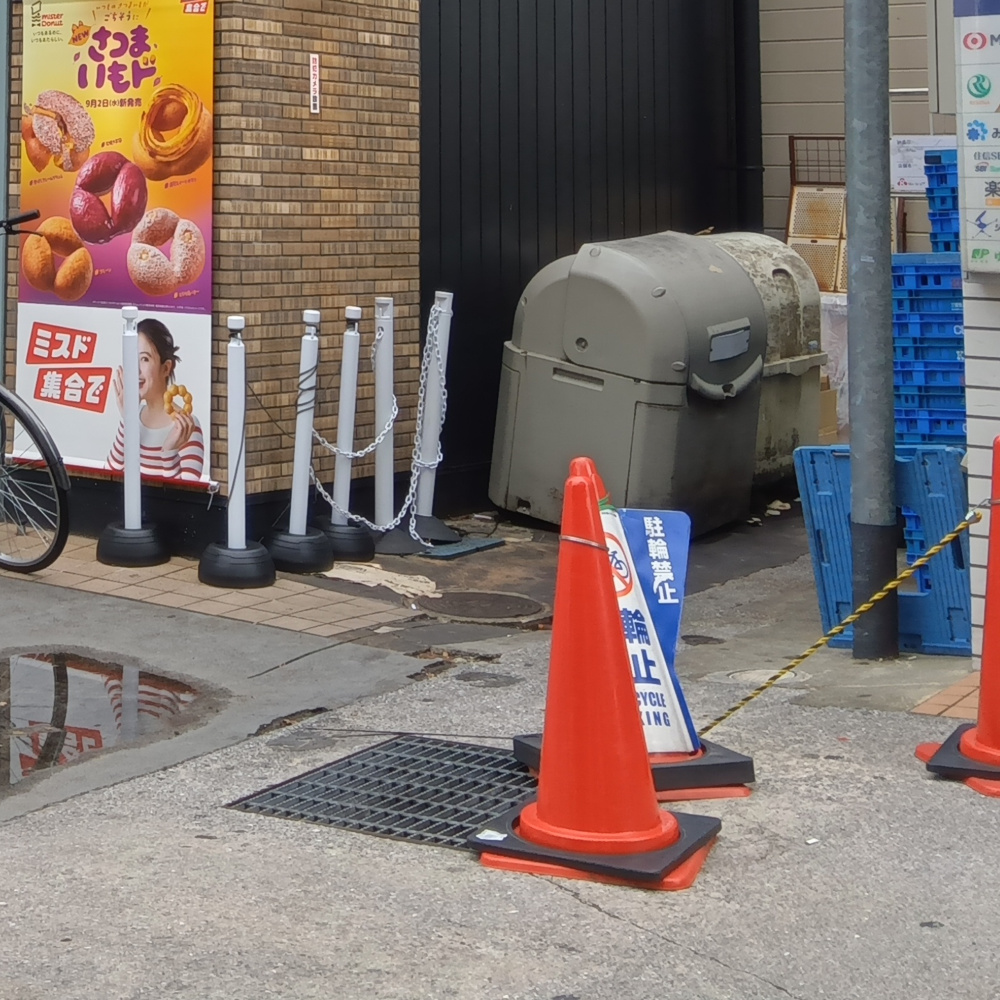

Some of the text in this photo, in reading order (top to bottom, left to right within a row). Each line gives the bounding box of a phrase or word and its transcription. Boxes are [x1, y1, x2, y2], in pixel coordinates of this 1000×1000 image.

[71, 30, 90, 44] NEW
[88, 25, 151, 62] さつま
[78, 55, 157, 93] いもド
[33, 328, 92, 359] ミスド
[40, 371, 107, 405] 集合で
[643, 516, 679, 604] 駐輪禁止
[619, 608, 651, 646] 輪
[630, 649, 661, 685] 止
